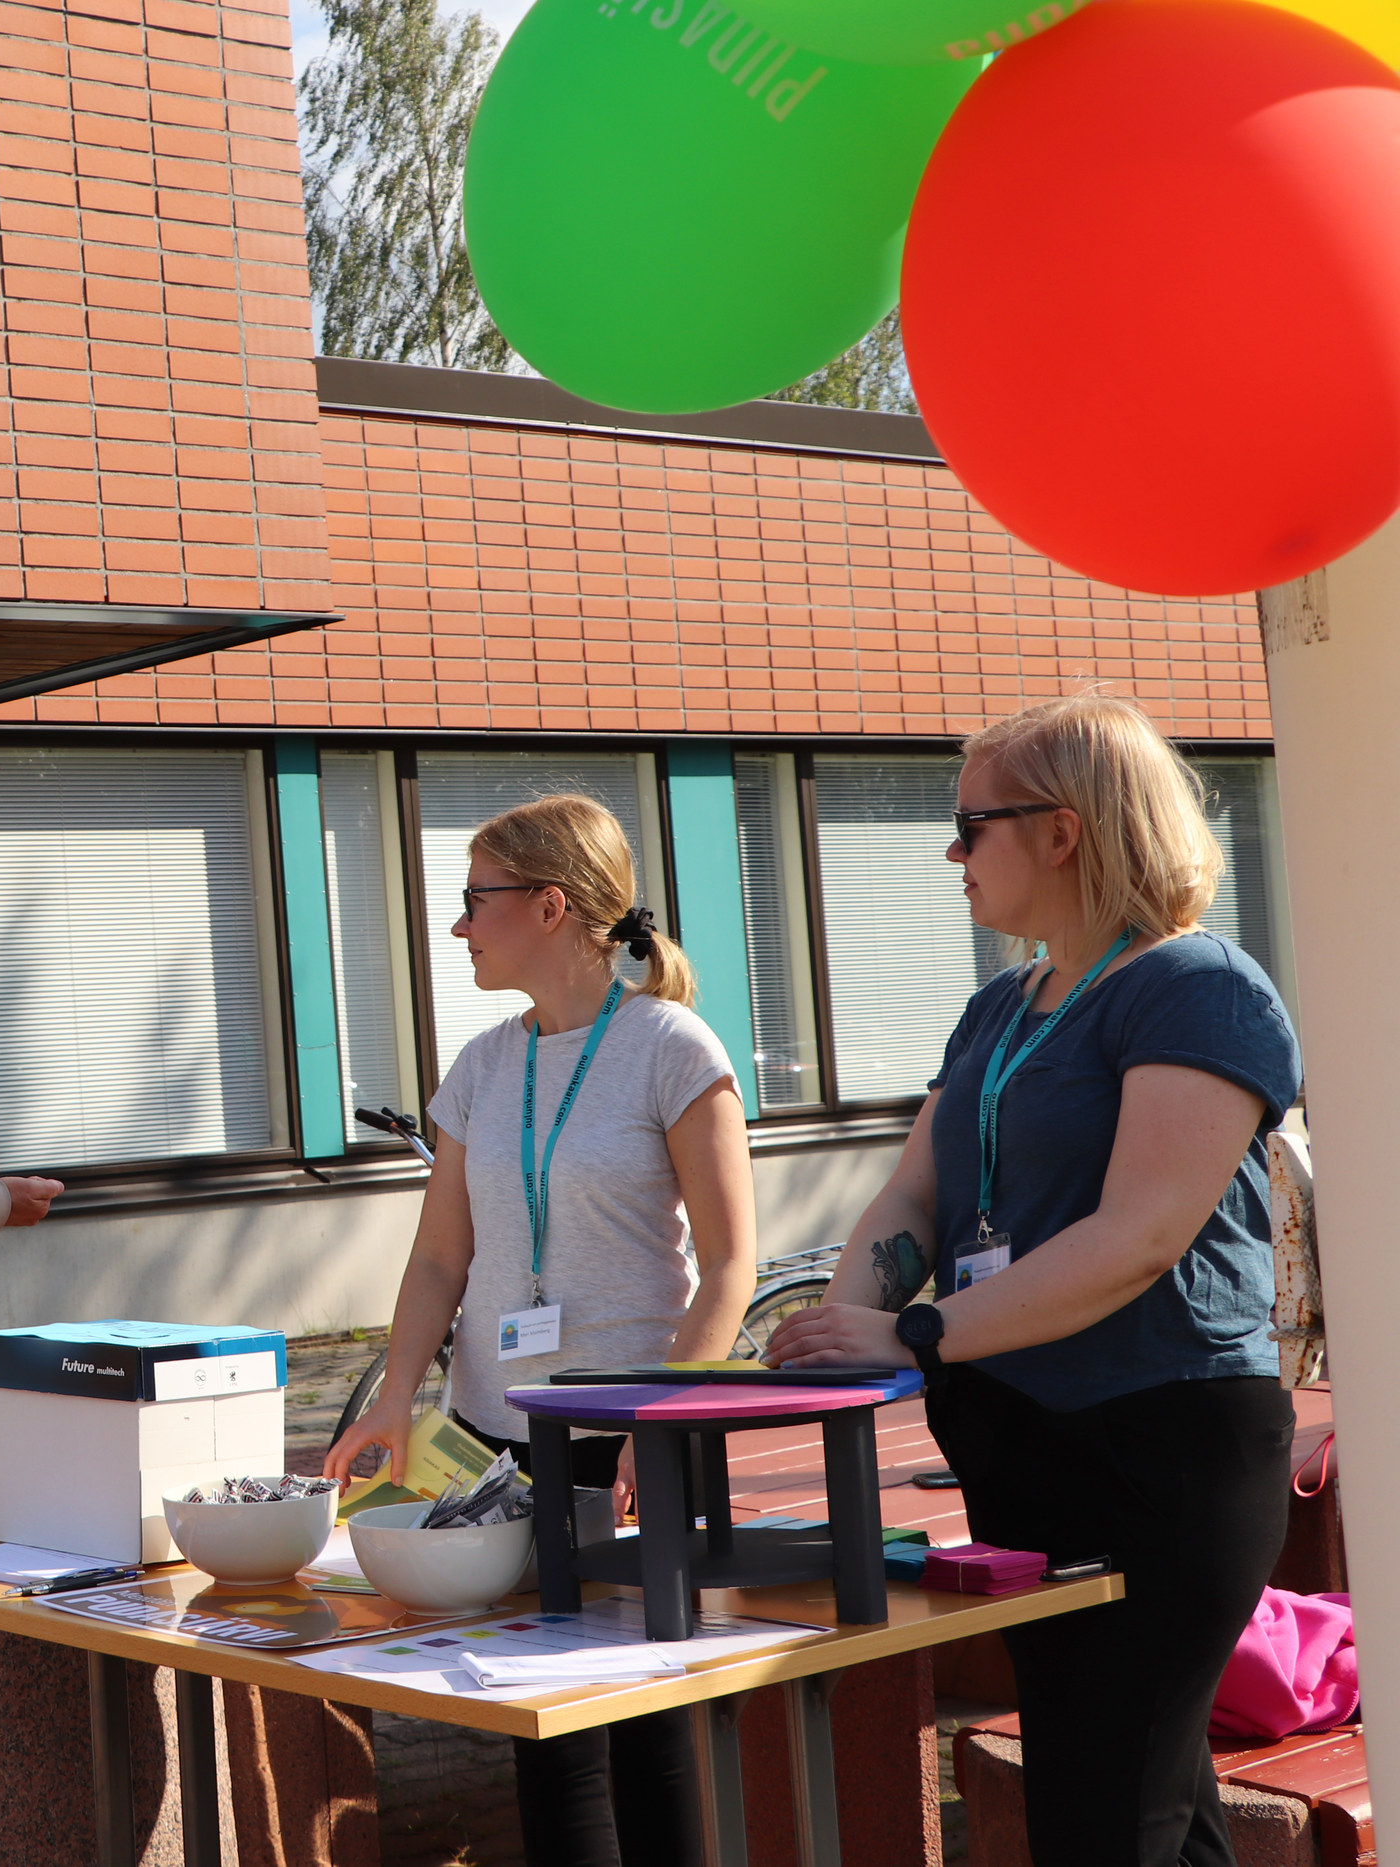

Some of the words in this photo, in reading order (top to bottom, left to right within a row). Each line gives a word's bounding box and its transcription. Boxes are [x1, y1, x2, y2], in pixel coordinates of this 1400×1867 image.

[1025, 977, 1088, 1048] oulunkaari.com
[525, 1059, 535, 1129] oulunkaari.com
[554, 1055, 588, 1126] oulunkaari.com
[61, 1357, 95, 1374] Future
[96, 1366, 125, 1377] multitech
